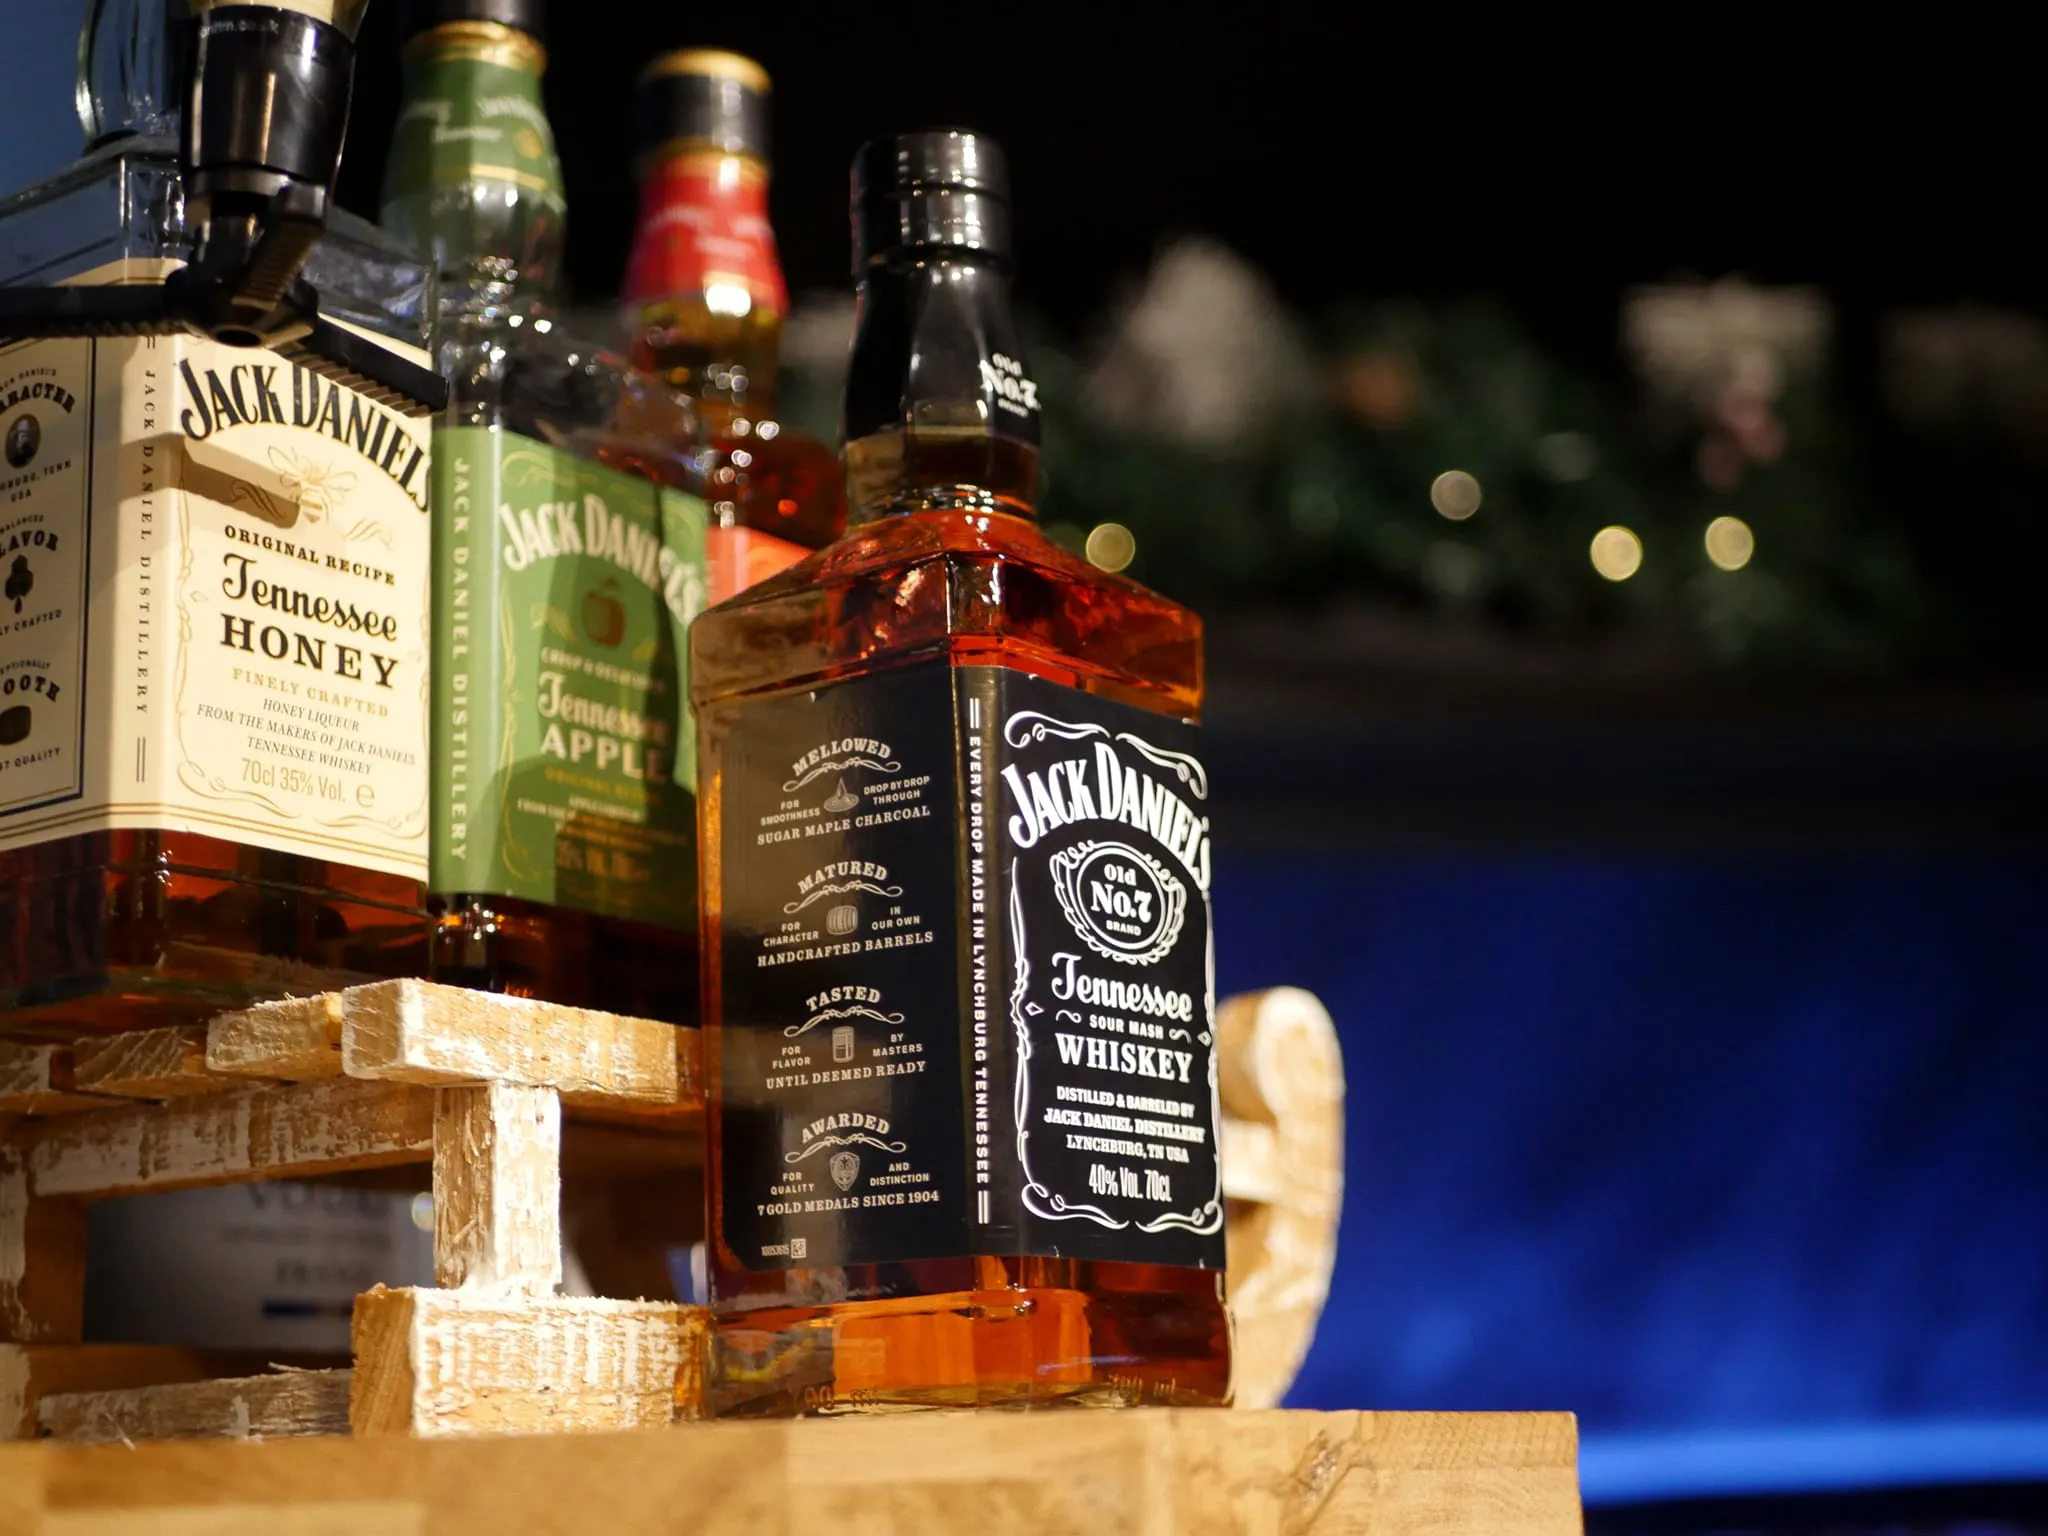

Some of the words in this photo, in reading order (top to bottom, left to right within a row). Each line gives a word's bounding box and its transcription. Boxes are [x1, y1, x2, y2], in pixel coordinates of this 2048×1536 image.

[143, 369, 156, 430] JACK
[180, 358, 287, 441] JACK
[140, 445, 155, 540] DANIEL
[453, 457, 470, 534] JACK
[499, 501, 584, 572] JACK
[224, 524, 320, 564] ORIGINAL
[326, 555, 396, 586] RECIPE
[222, 552, 398, 642] Tennessee
[452, 546, 469, 660] DANIEL
[14, 609, 62, 631] CRAFTED
[136, 555, 151, 714] DISTILLERY
[219, 612, 399, 690] HONEY
[232, 668, 300, 696] FINELY
[307, 687, 389, 718] CRAFTED
[196, 703, 234, 723] FROM
[238, 712, 264, 730] THE
[266, 719, 317, 742] MAKERS
[320, 732, 335, 746] OF
[336, 737, 366, 753] JACK
[263, 698, 305, 719] HONEY
[307, 709, 360, 733] LIQUEUR
[14, 747, 61, 767] QUALITY
[247, 736, 315, 763] TENNESSEE
[319, 751, 372, 775] WHISKEY
[451, 674, 469, 861] DISTILLERY
[792, 738, 891, 777] MELLOWED
[970, 736, 983, 797] EVERY
[241, 757, 276, 788] 70cl
[280, 767, 314, 797] 35%
[318, 775, 346, 803] Vol.
[863, 783, 889, 796] DROP
[890, 780, 902, 789] BY
[903, 775, 930, 789] DROP
[780, 800, 800, 811] FOR
[873, 790, 921, 805] THROUGH
[1000, 758, 1099, 849] JACK
[757, 828, 801, 846] SUGAR
[805, 819, 851, 838] MAPLE
[855, 805, 931, 828] CHARCOAL
[760, 807, 821, 826] SMOOTHNESS
[971, 802, 984, 854] DROP
[798, 861, 888, 894] MATURED
[972, 859, 985, 914] MADE
[1104, 863, 1137, 886] Old
[890, 906, 901, 916] IN
[1090, 880, 1153, 924] No.7
[763, 930, 819, 948] CHARACTER
[781, 922, 801, 933] FOR
[871, 919, 893, 931] OUR
[896, 915, 921, 927] OWN
[973, 919, 985, 939] IN
[1105, 919, 1142, 937] BRAND
[757, 942, 861, 968] HANDCRAFTED
[865, 931, 934, 952] BARRELS
[806, 986, 881, 1012] TASTED
[973, 944, 987, 1062] LYNCHBURG
[1051, 952, 1194, 1023] Tennessee
[890, 1033, 904, 1044] BY
[1089, 1014, 1125, 1033] SOUR
[1129, 1021, 1165, 1040] MASH
[772, 1056, 811, 1070] FLAVOR
[781, 1045, 801, 1056] FOR
[872, 1043, 923, 1058] MASTERS
[1055, 1032, 1194, 1084] WHISKEY
[766, 1074, 809, 1090] UNTIL
[812, 1067, 873, 1086] DEEMED
[876, 1060, 927, 1078] READY
[1056, 1086, 1115, 1107] DISTILLED
[1116, 1093, 1126, 1109] &
[1126, 1095, 1180, 1118] BARRELED
[1180, 1102, 1196, 1119] BY
[801, 1112, 891, 1144] AWARDED
[975, 1067, 989, 1184] TENNESSEE
[1044, 1108, 1083, 1127] JACK
[1083, 1112, 1134, 1133] DANIEL
[1134, 1118, 1206, 1144] DISTILLERY
[1066, 1134, 1147, 1160] LYNCHBURG,
[1146, 1144, 1165, 1160] TN
[1166, 1146, 1190, 1164] USA
[782, 1171, 803, 1182] FOR
[869, 1172, 930, 1188] DISTINCTION
[888, 1161, 910, 1173] AND
[1088, 1163, 1119, 1197] 40%
[770, 1182, 815, 1196] QUALITY
[804, 1197, 860, 1214] MEDALS
[863, 1192, 905, 1209] SINCE
[908, 1190, 940, 1205] 1904
